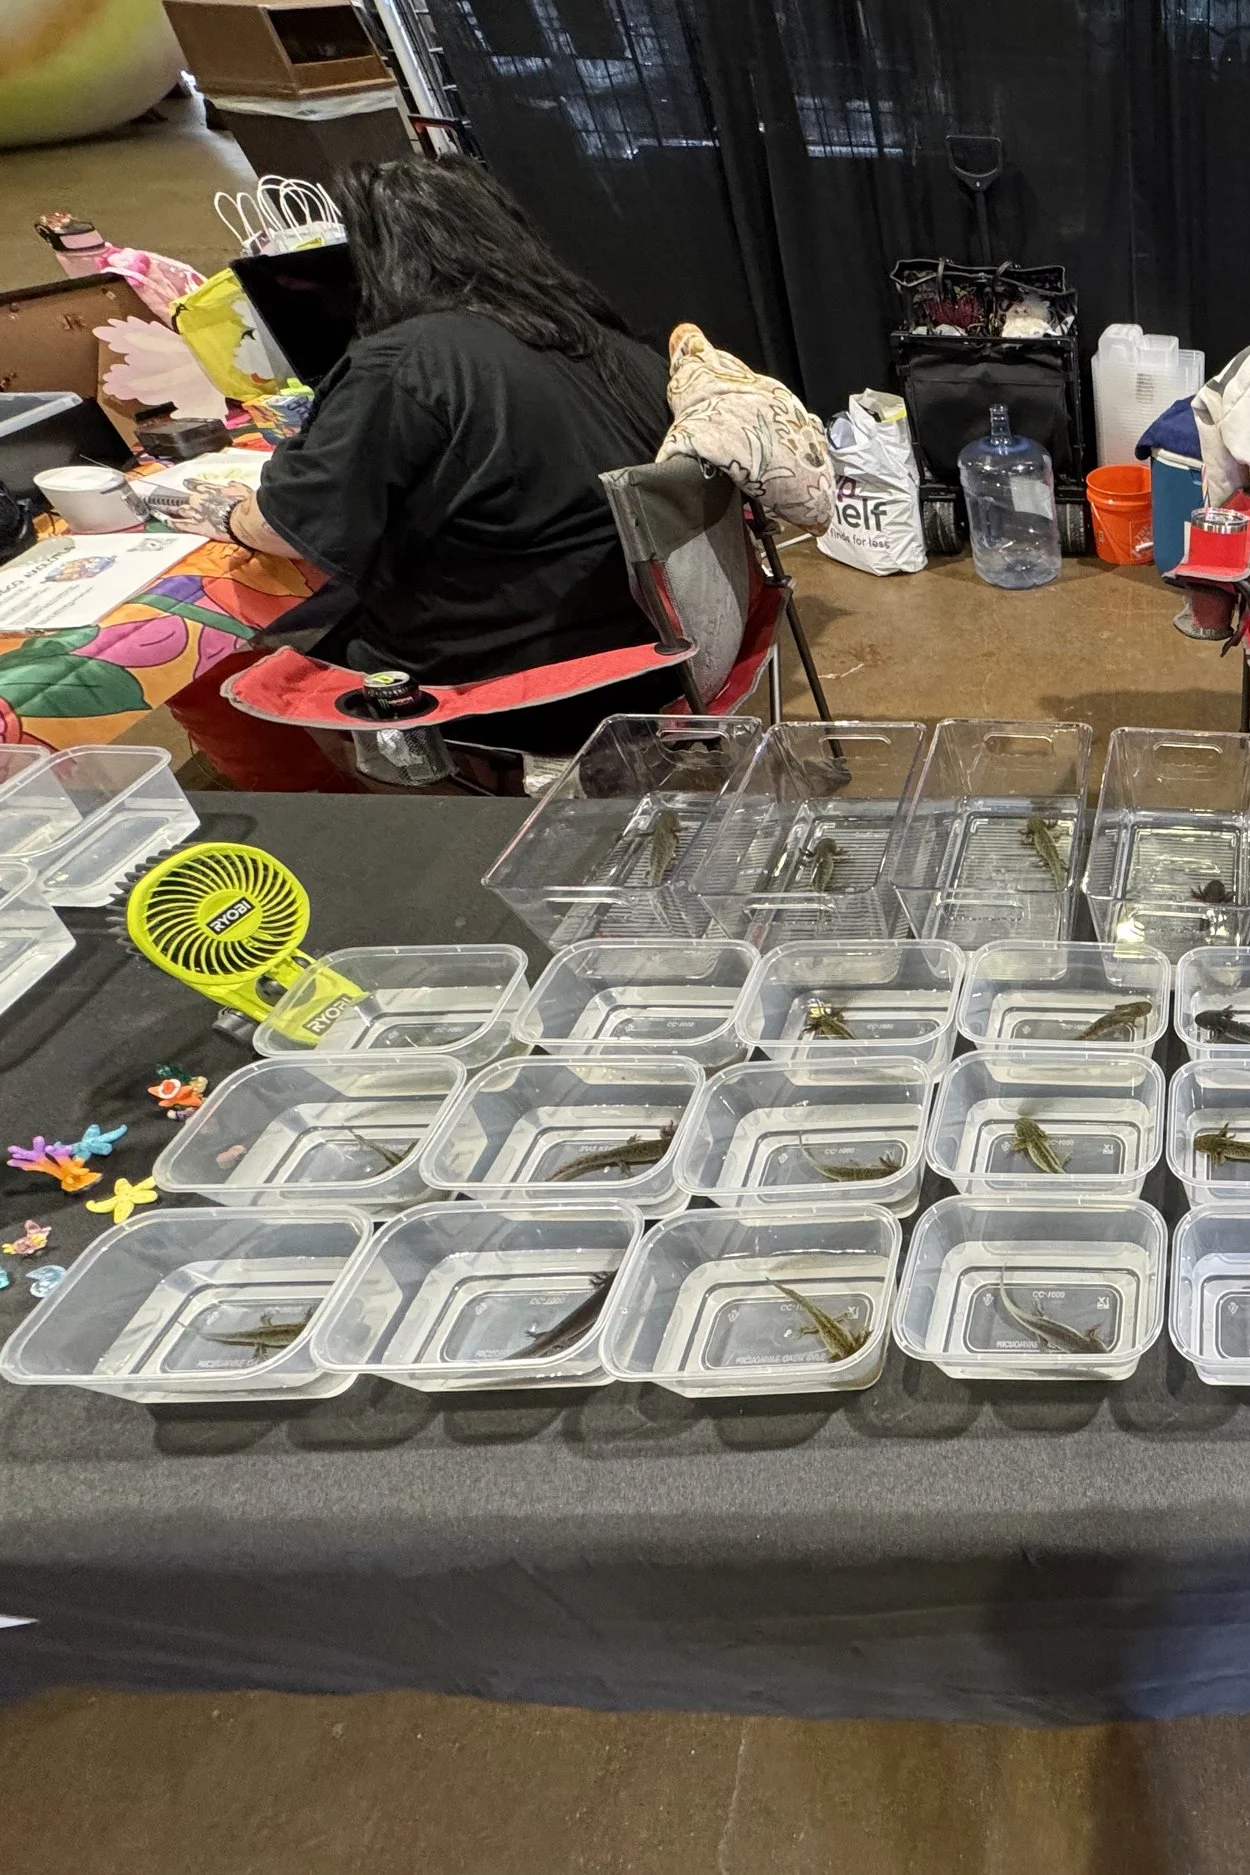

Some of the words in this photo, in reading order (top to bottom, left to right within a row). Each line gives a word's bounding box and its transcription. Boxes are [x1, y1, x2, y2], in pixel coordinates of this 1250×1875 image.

[853, 534, 867, 546] for
[869, 537, 890, 549] less
[209, 900, 252, 932] RYOBI
[307, 996, 351, 1032] RYOBI
